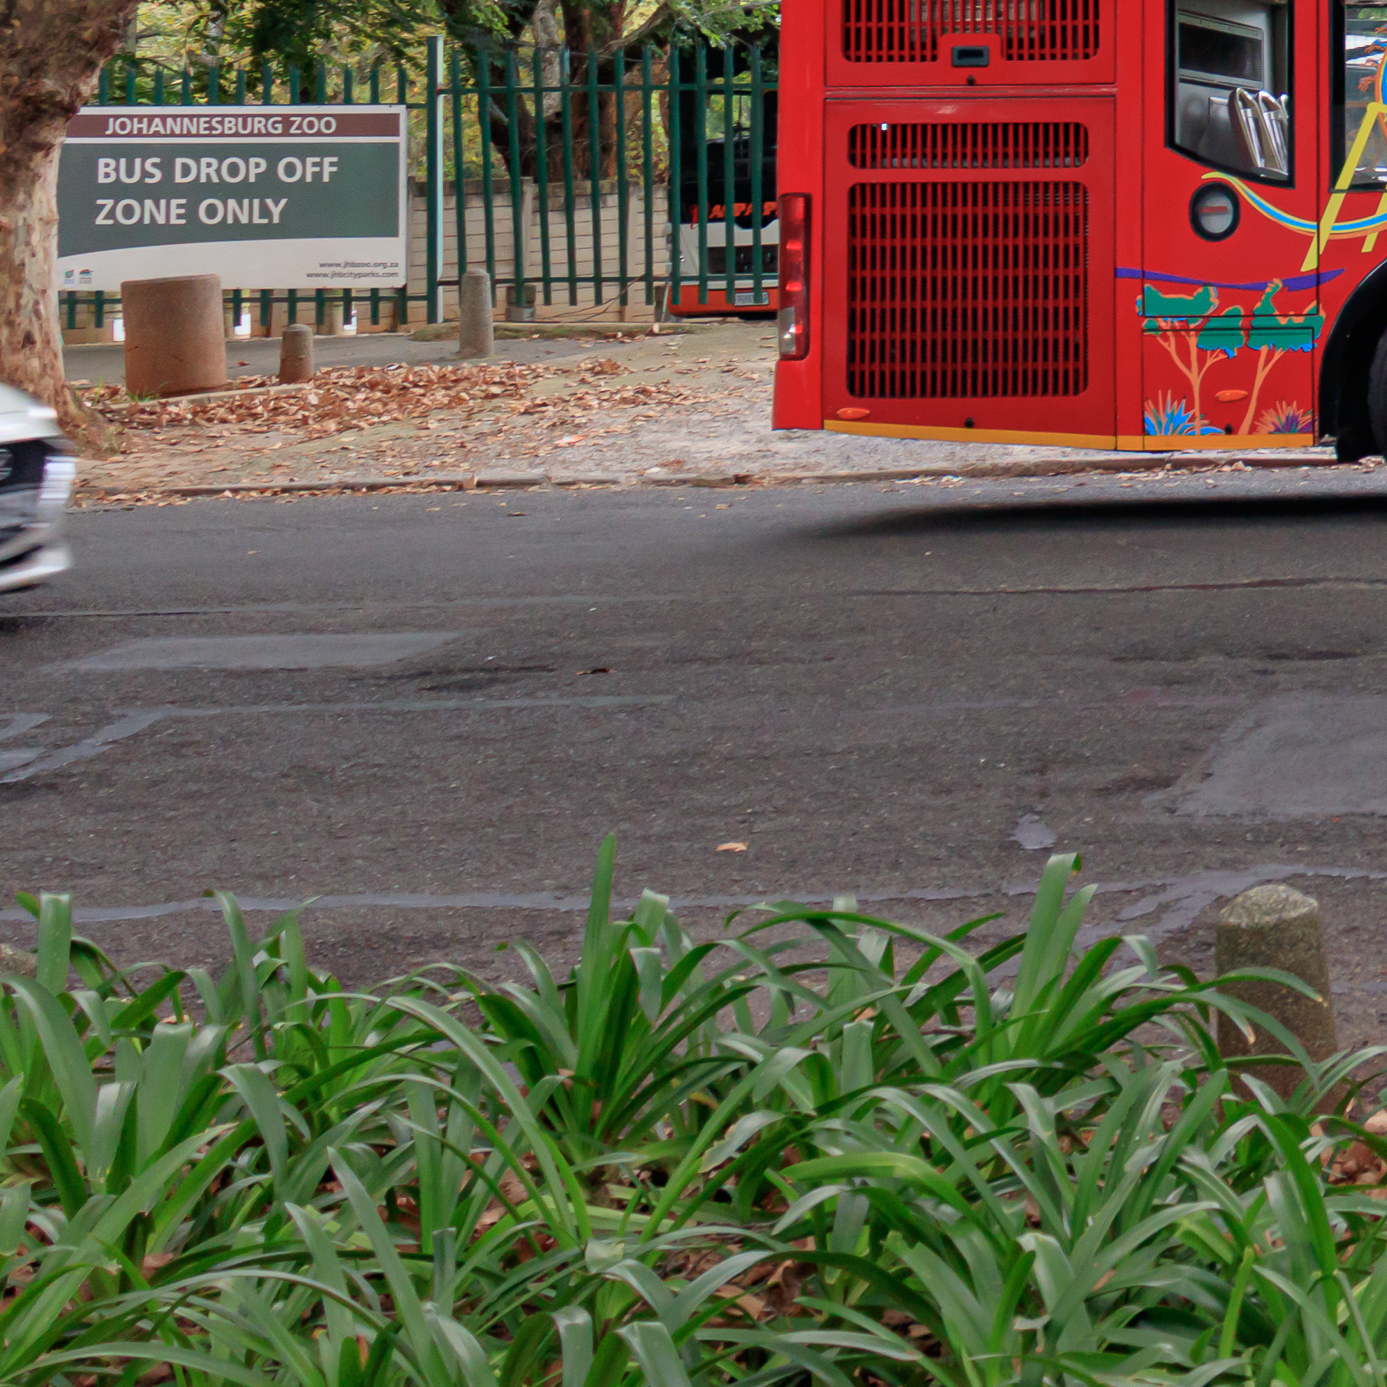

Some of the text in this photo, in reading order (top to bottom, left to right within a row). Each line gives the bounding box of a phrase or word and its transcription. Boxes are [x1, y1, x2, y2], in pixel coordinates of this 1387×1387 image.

[105, 116, 337, 136] JOHANNESBURG ZOO
[97, 156, 339, 185] BUS DROP OFF
[95, 197, 289, 226] ZONE ONLY
